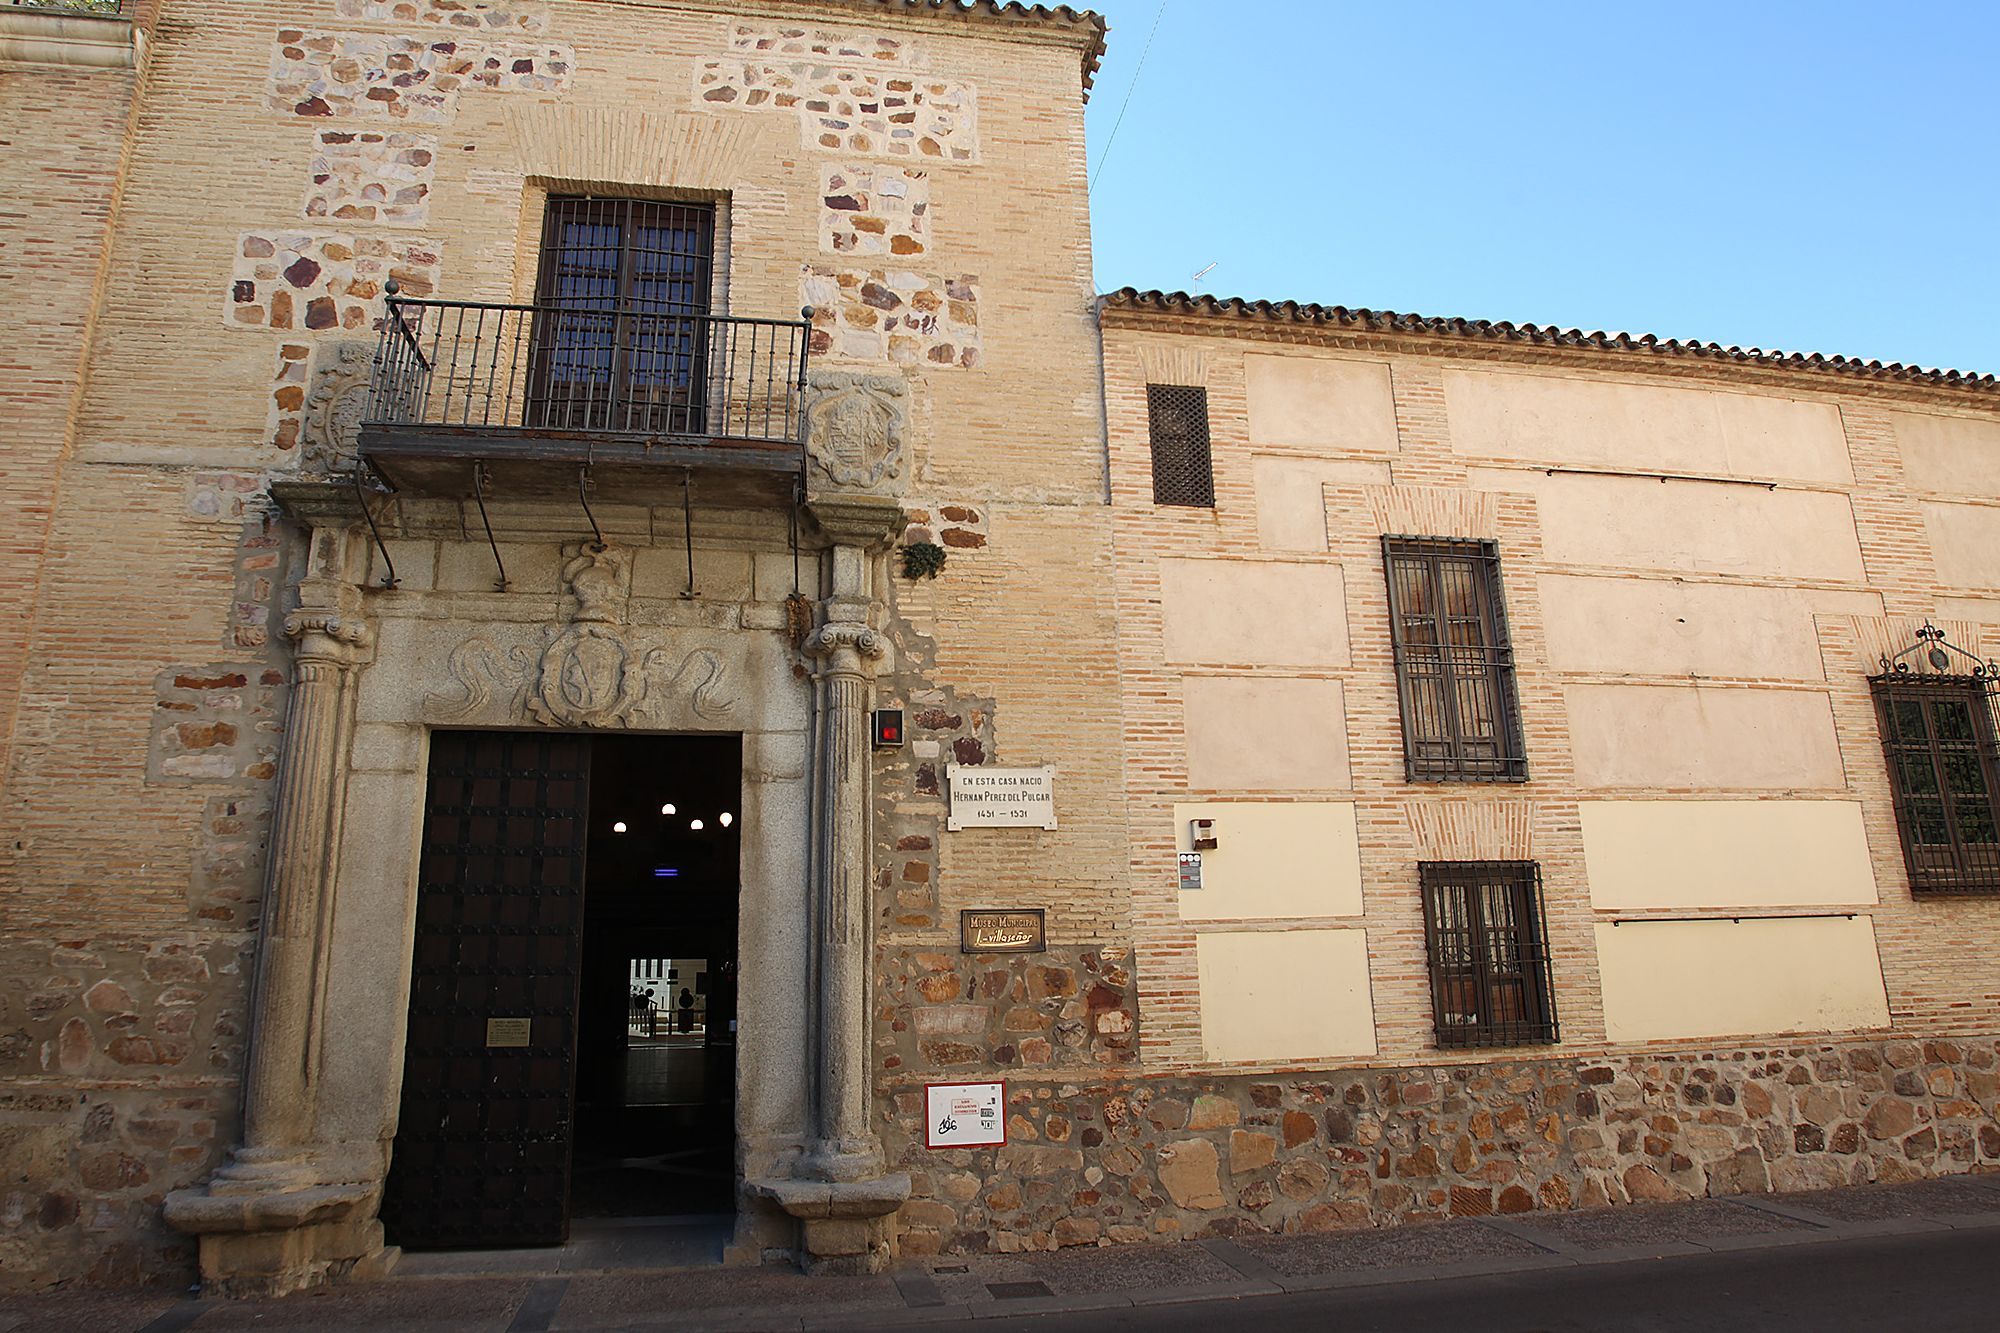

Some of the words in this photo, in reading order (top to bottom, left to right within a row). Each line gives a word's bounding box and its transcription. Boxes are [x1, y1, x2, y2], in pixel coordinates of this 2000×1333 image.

[963, 777, 973, 786] EN
[975, 777, 996, 786] ESTA
[998, 777, 1018, 786] CASA
[1019, 777, 1042, 786] NACIO
[954, 791, 983, 802] HERNAN
[984, 790, 1007, 802] PEREZ
[1007, 793, 1021, 802] DEL
[1022, 790, 1050, 802] PULGAR
[977, 810, 995, 818] 1451
[1010, 810, 1028, 818] 1531
[970, 916, 997, 928] MUSEO
